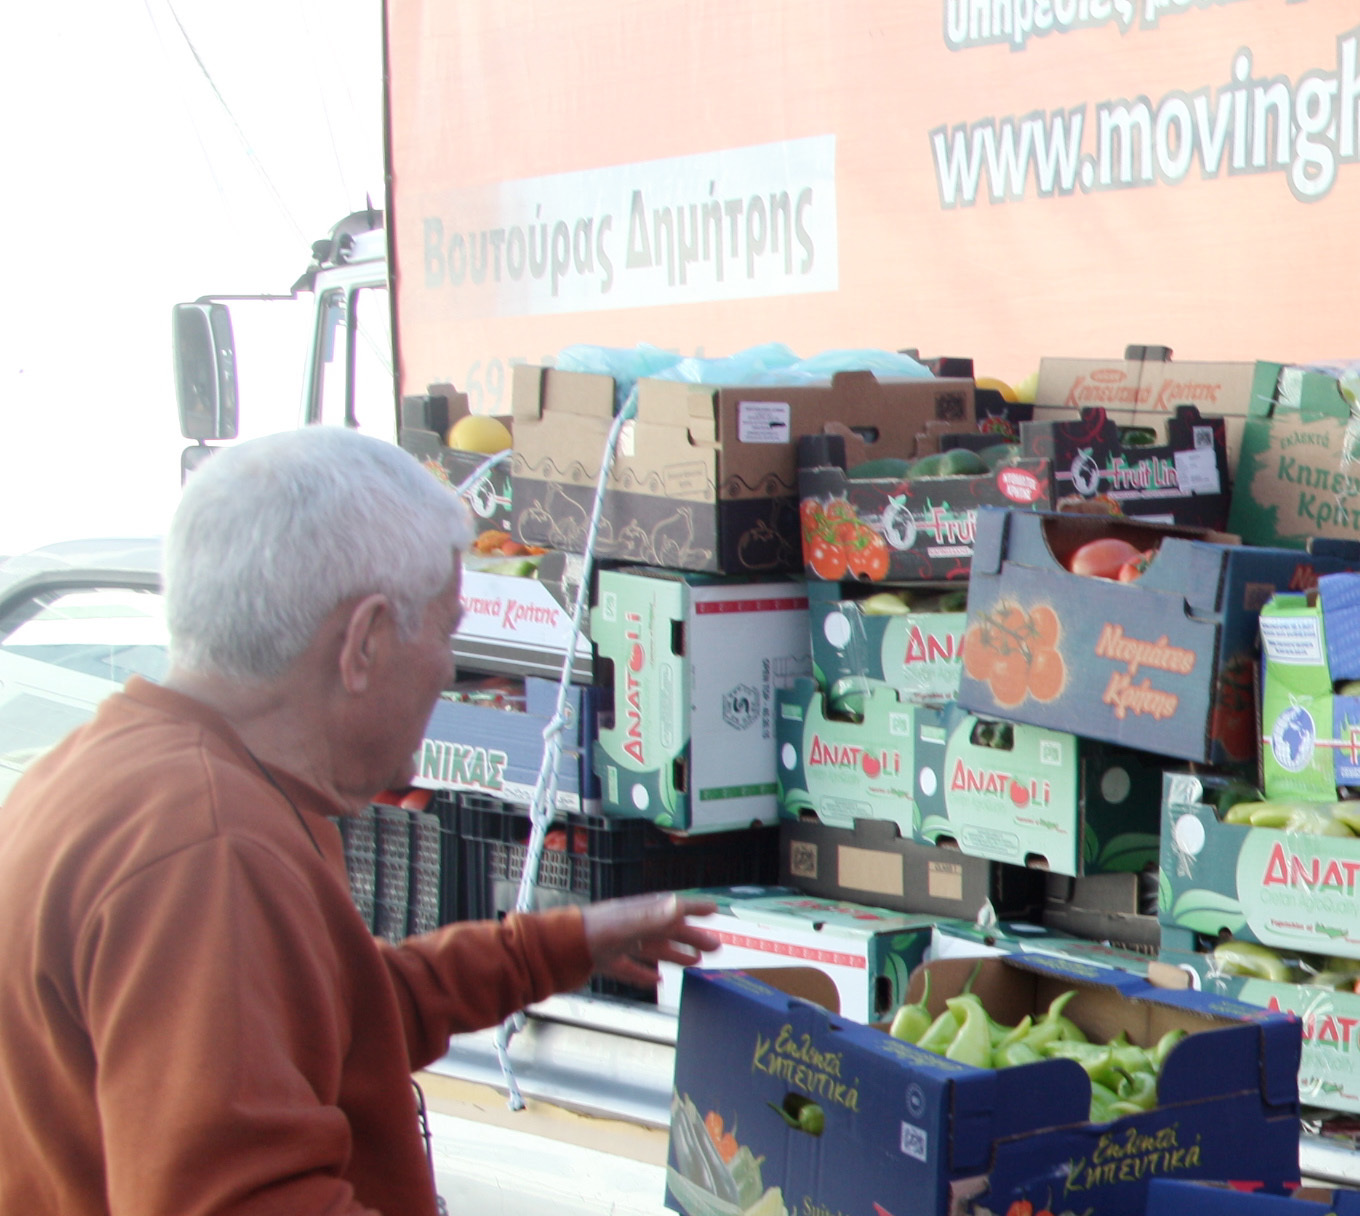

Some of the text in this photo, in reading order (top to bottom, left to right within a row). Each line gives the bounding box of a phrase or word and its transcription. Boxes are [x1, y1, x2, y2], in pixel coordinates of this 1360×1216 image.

[423, 180, 816, 294] Βουτούρας Δημήτρης
[1111, 455, 1179, 490] Fruit Lin
[930, 506, 978, 545] Frui
[502, 602, 560, 633] Κρήτης
[419, 738, 509, 792] ΝΙΚΑΣ
